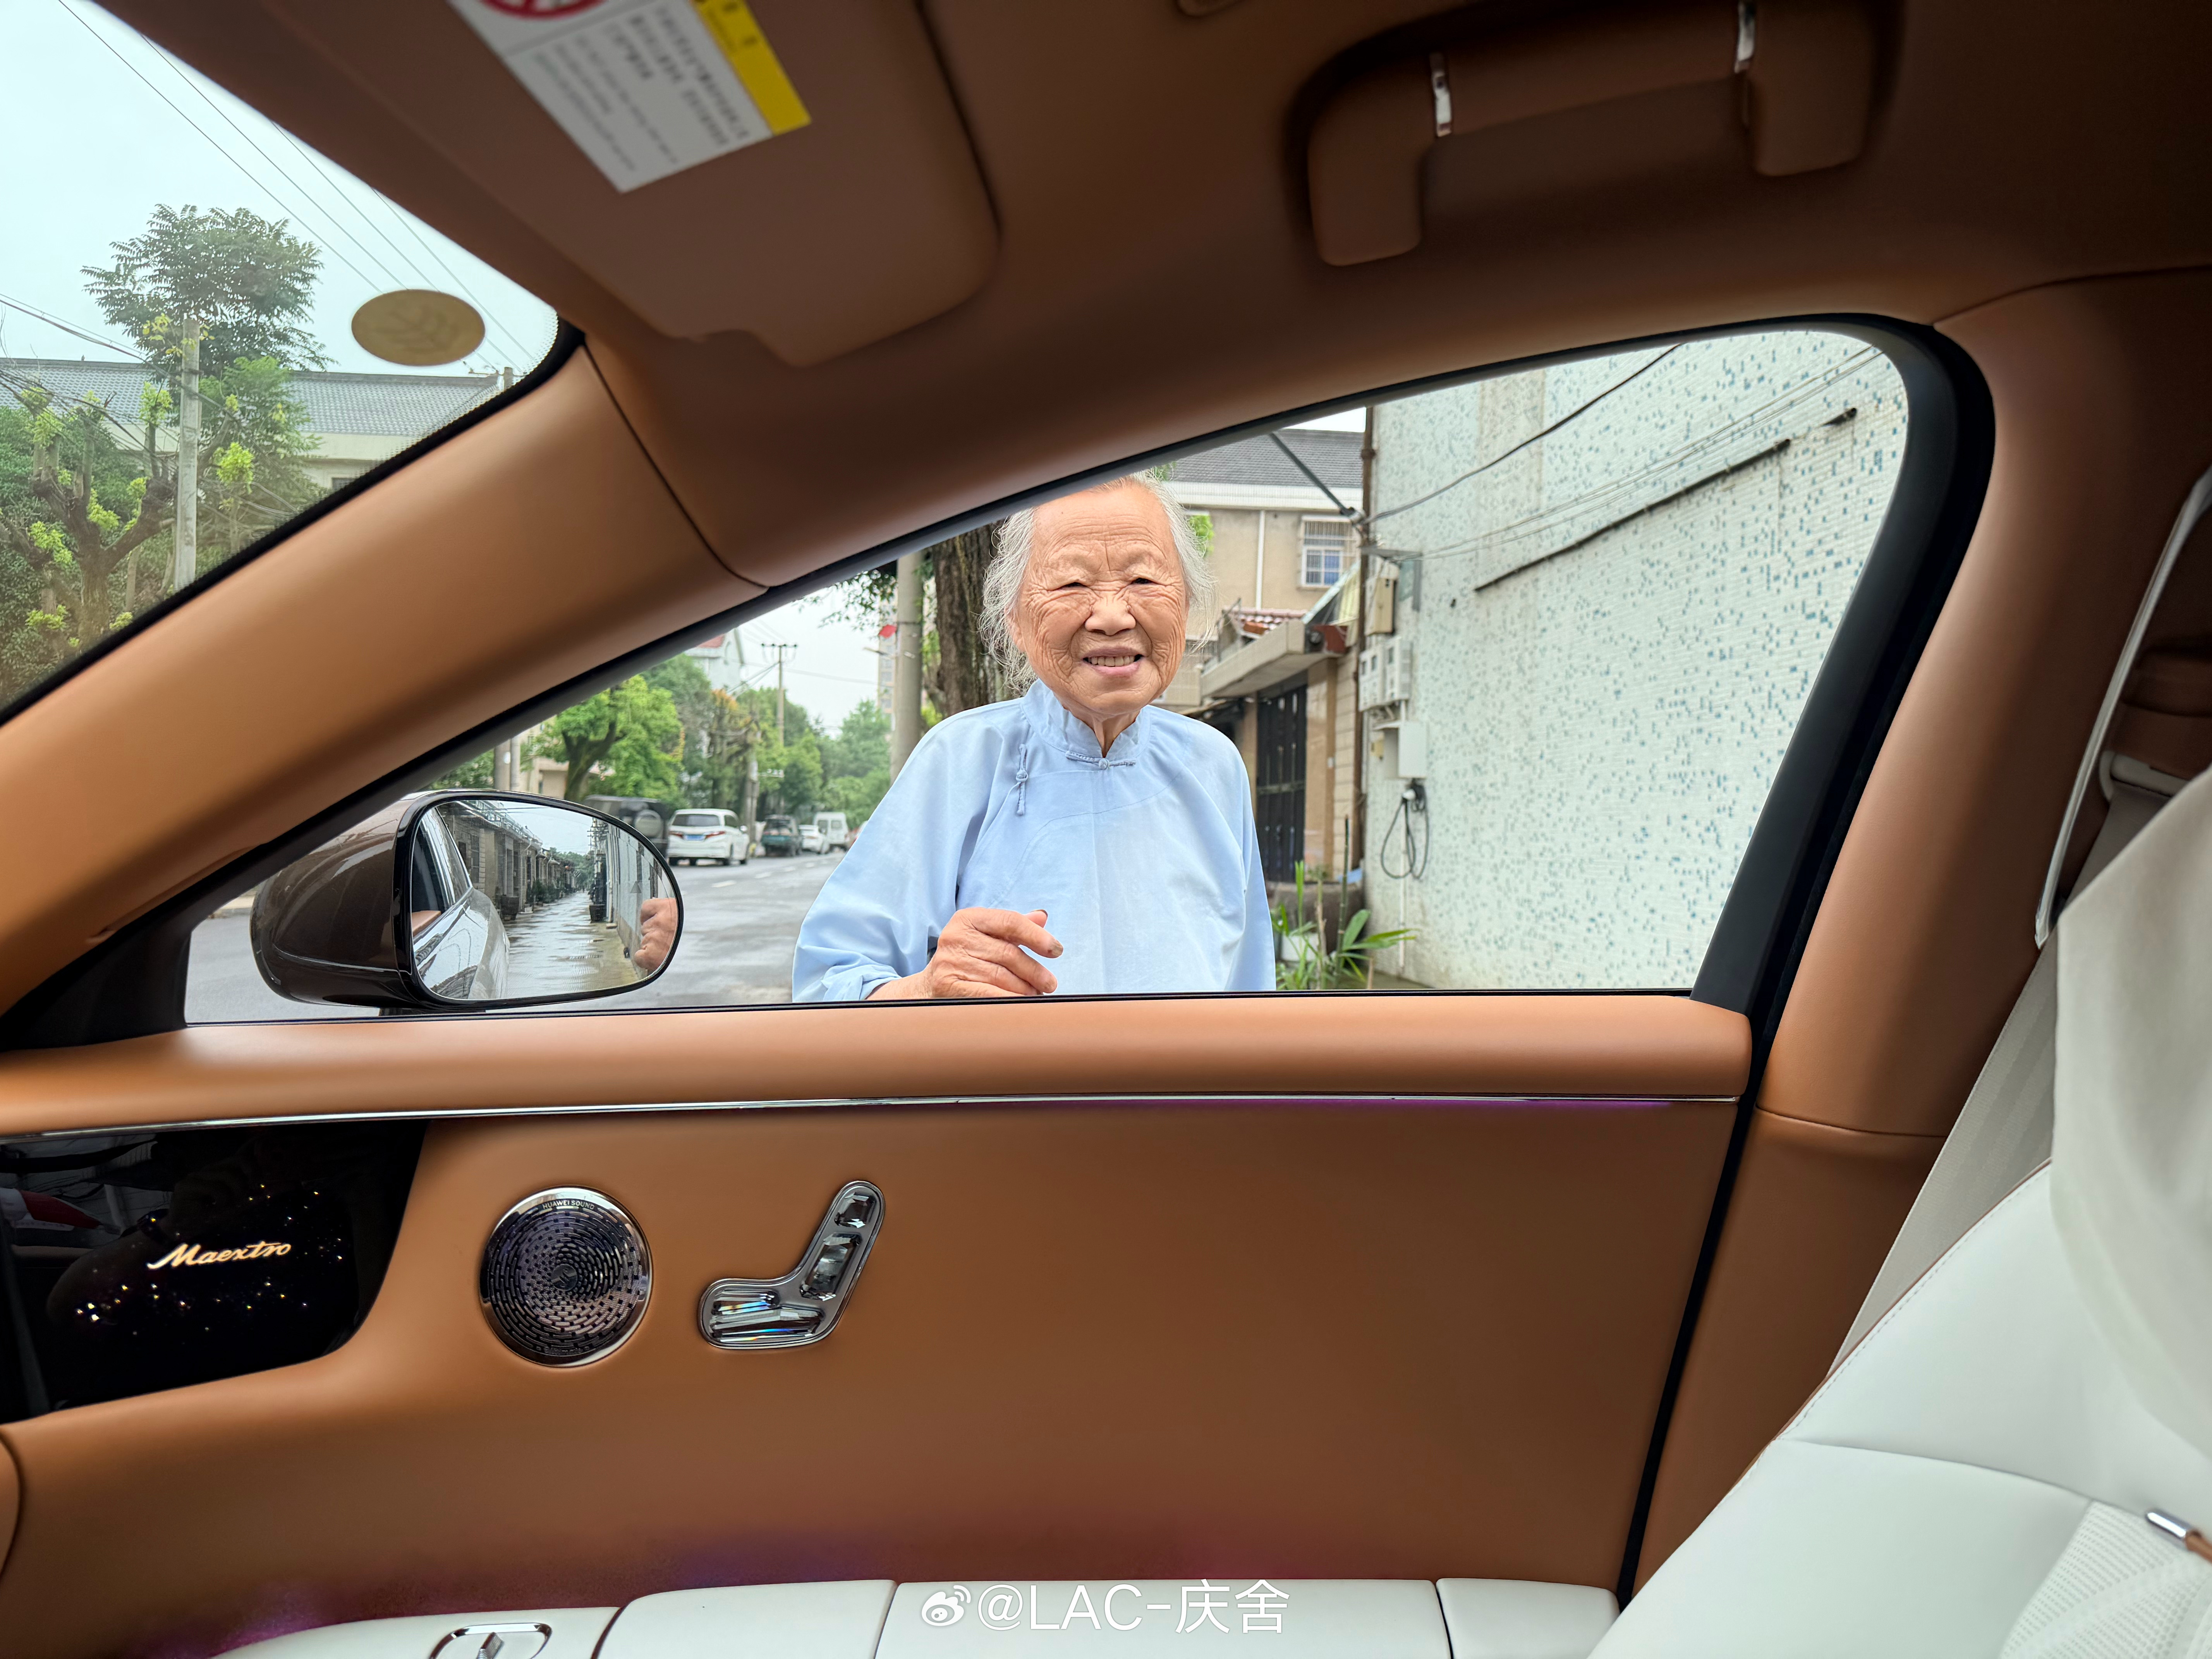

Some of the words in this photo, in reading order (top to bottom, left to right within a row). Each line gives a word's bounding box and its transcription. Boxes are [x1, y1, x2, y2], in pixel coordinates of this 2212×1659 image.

[543, 1200, 570, 1209] HUAWEI
[571, 1200, 595, 1209] SOUND
[147, 1241, 292, 1269] Maextro
